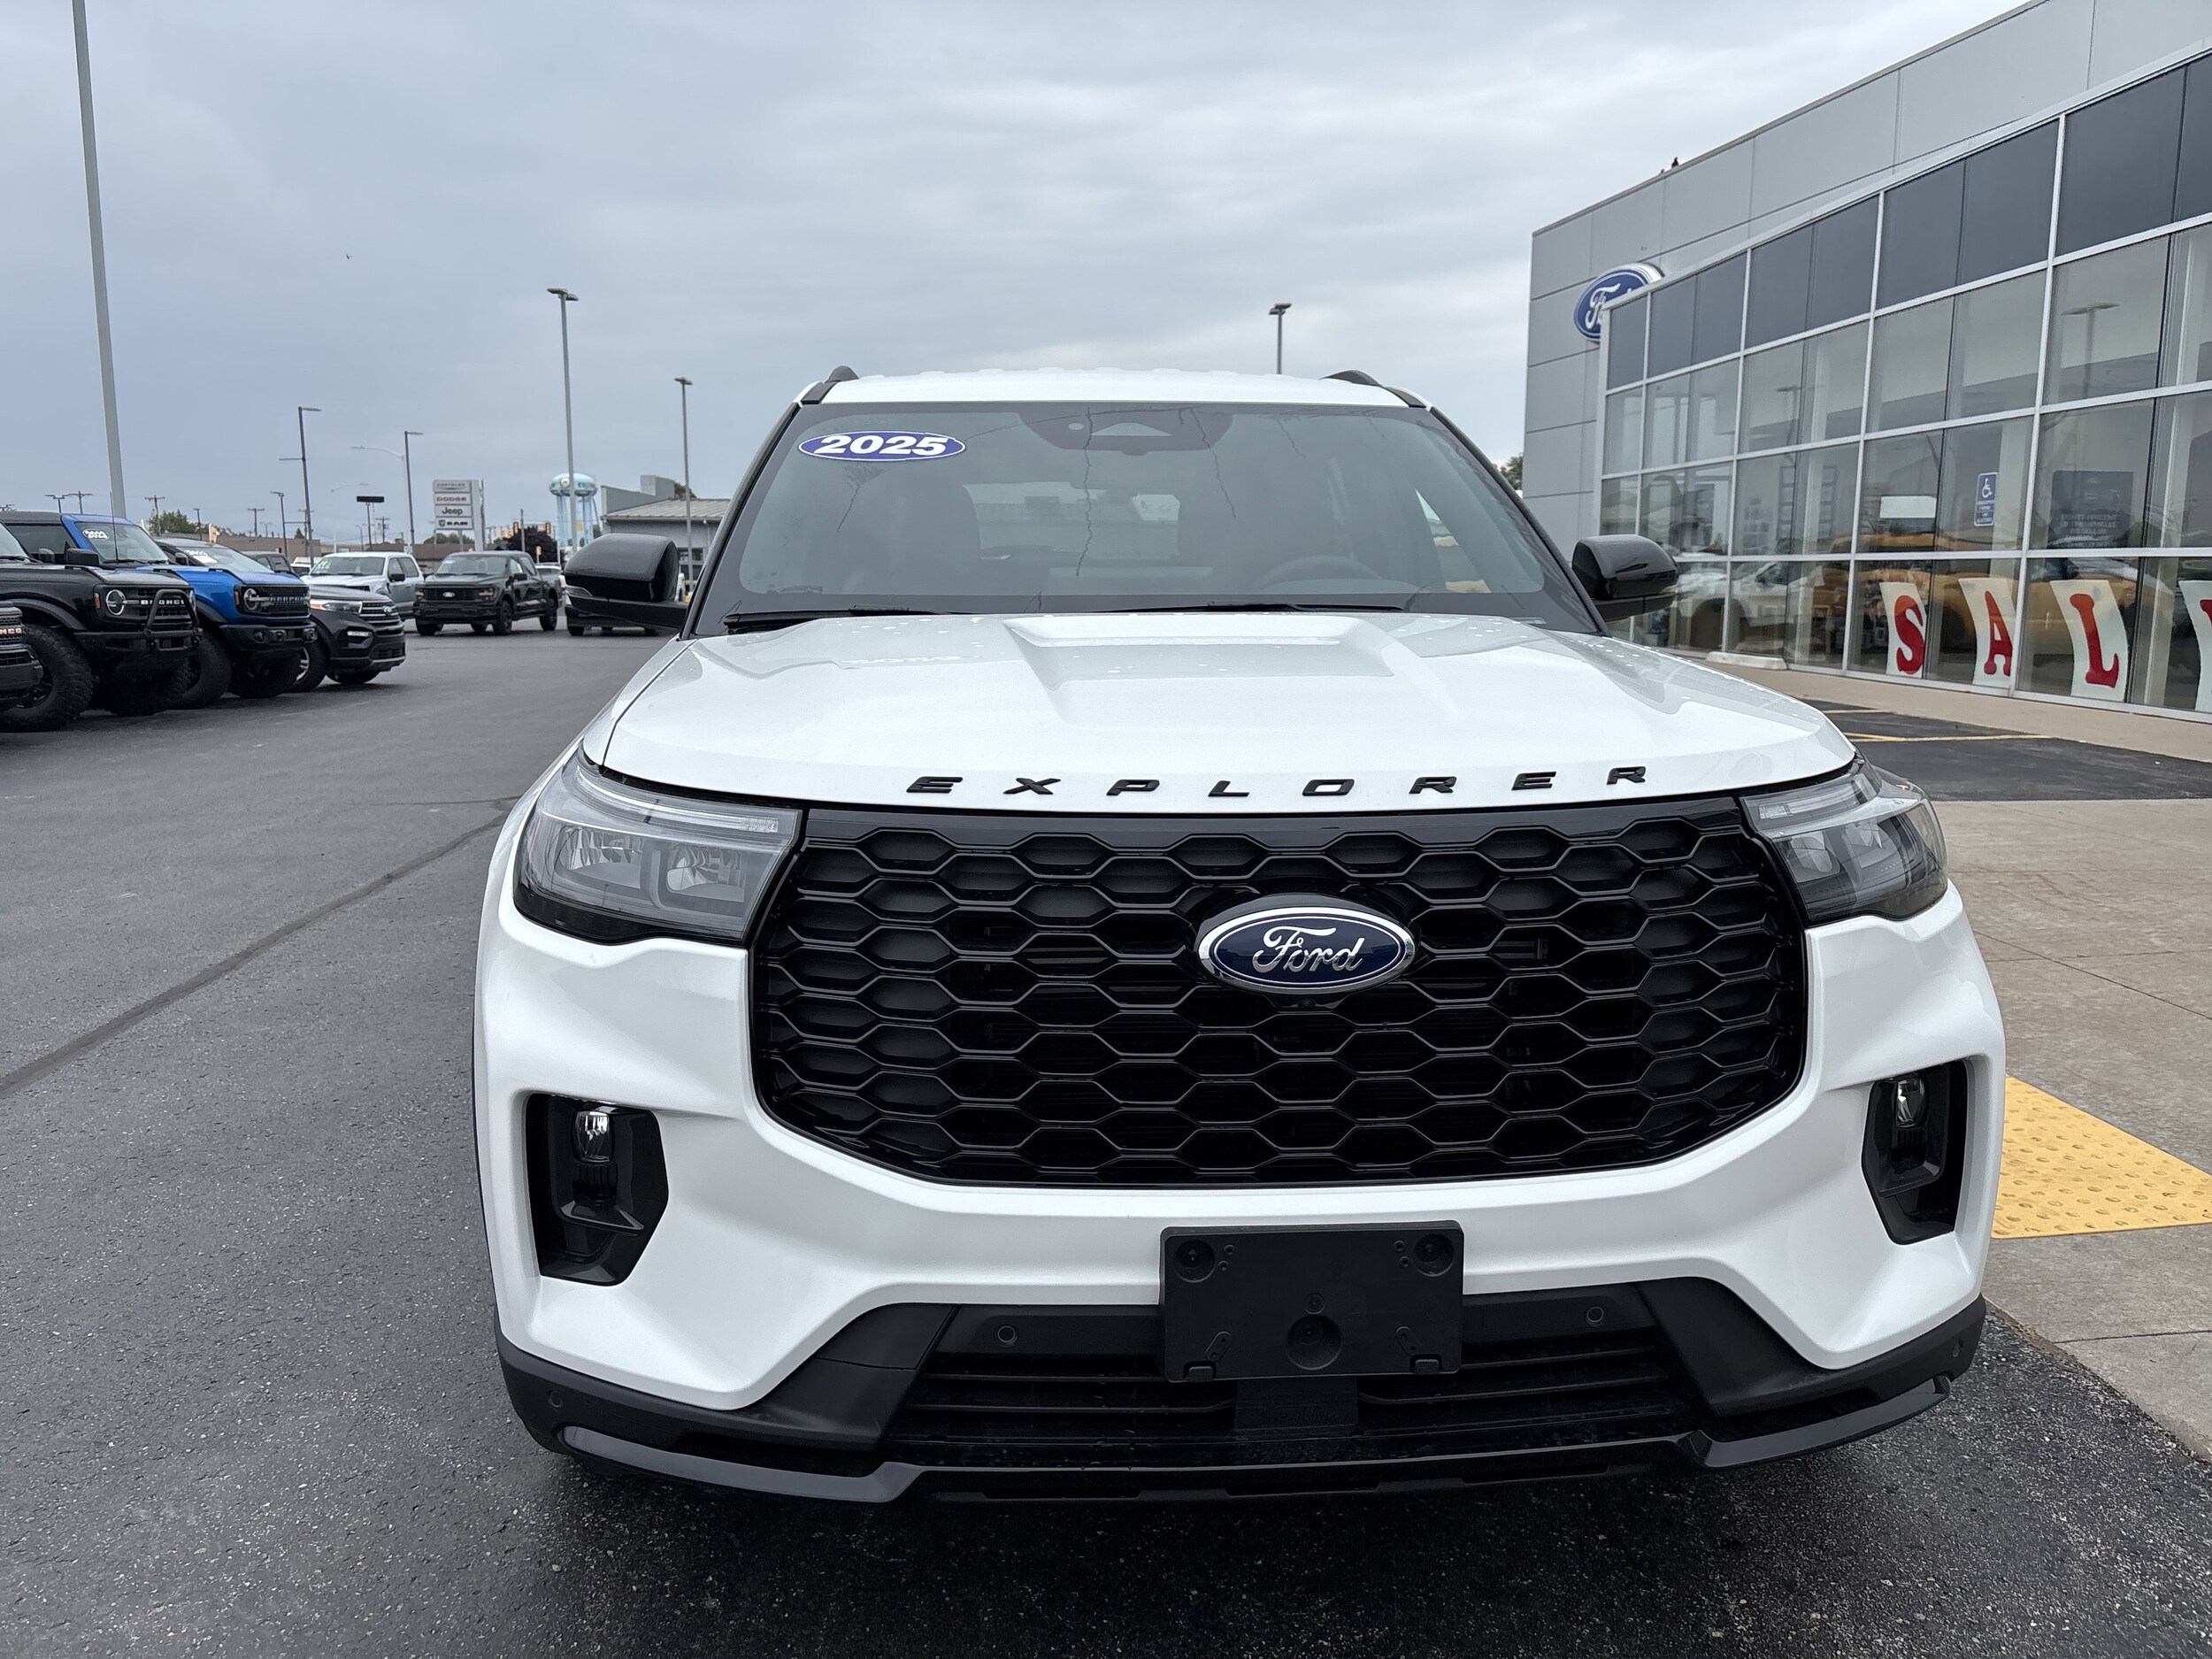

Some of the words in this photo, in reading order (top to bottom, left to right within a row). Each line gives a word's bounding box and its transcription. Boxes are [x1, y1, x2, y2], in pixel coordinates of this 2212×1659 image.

[813, 434, 949, 456] 2025
[442, 506, 464, 515] Jeep
[1894, 590, 2212, 689] SAL
[905, 764, 1647, 798] EXPLORER
[1252, 925, 1365, 973] Ford
